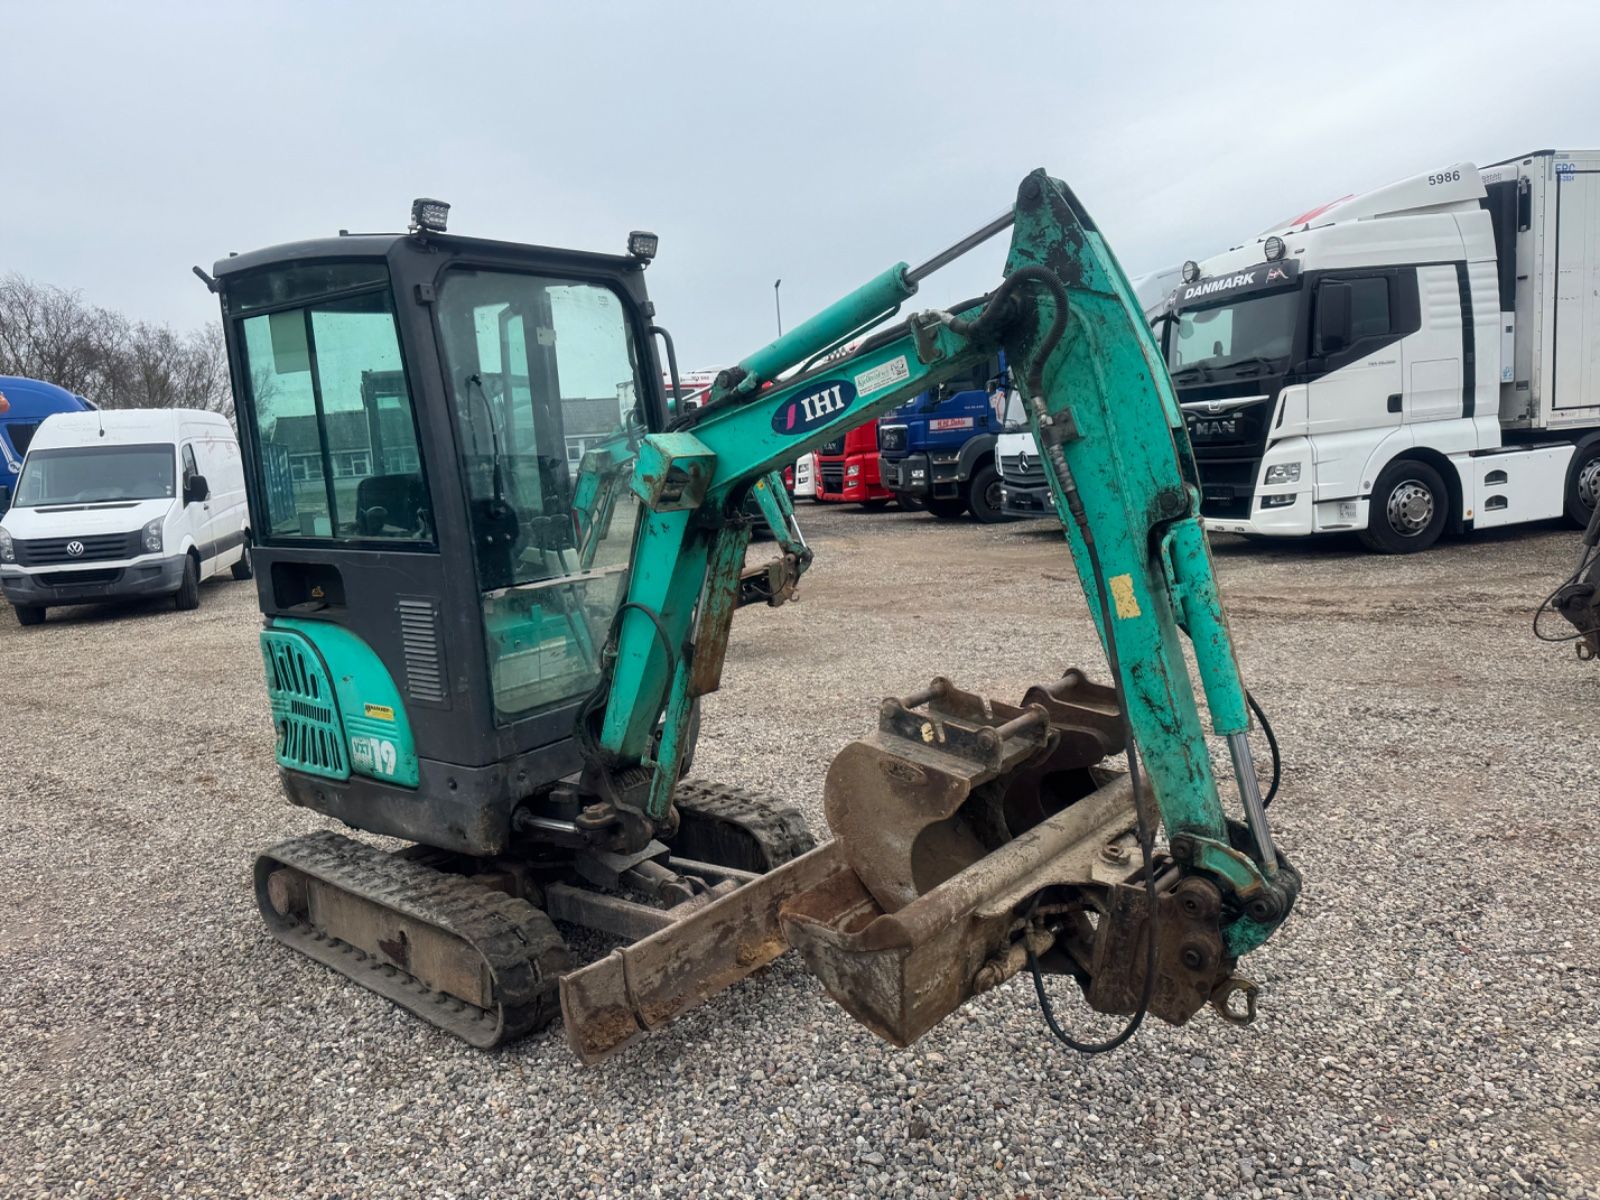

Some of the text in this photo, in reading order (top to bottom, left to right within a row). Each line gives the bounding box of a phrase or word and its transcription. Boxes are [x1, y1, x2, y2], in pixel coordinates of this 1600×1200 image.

[1428, 170, 1460, 186] 5986
[1184, 272, 1256, 300] DANMARK
[801, 385, 845, 422] IHI
[1196, 420, 1235, 435] MAN
[370, 737, 396, 776] 19
